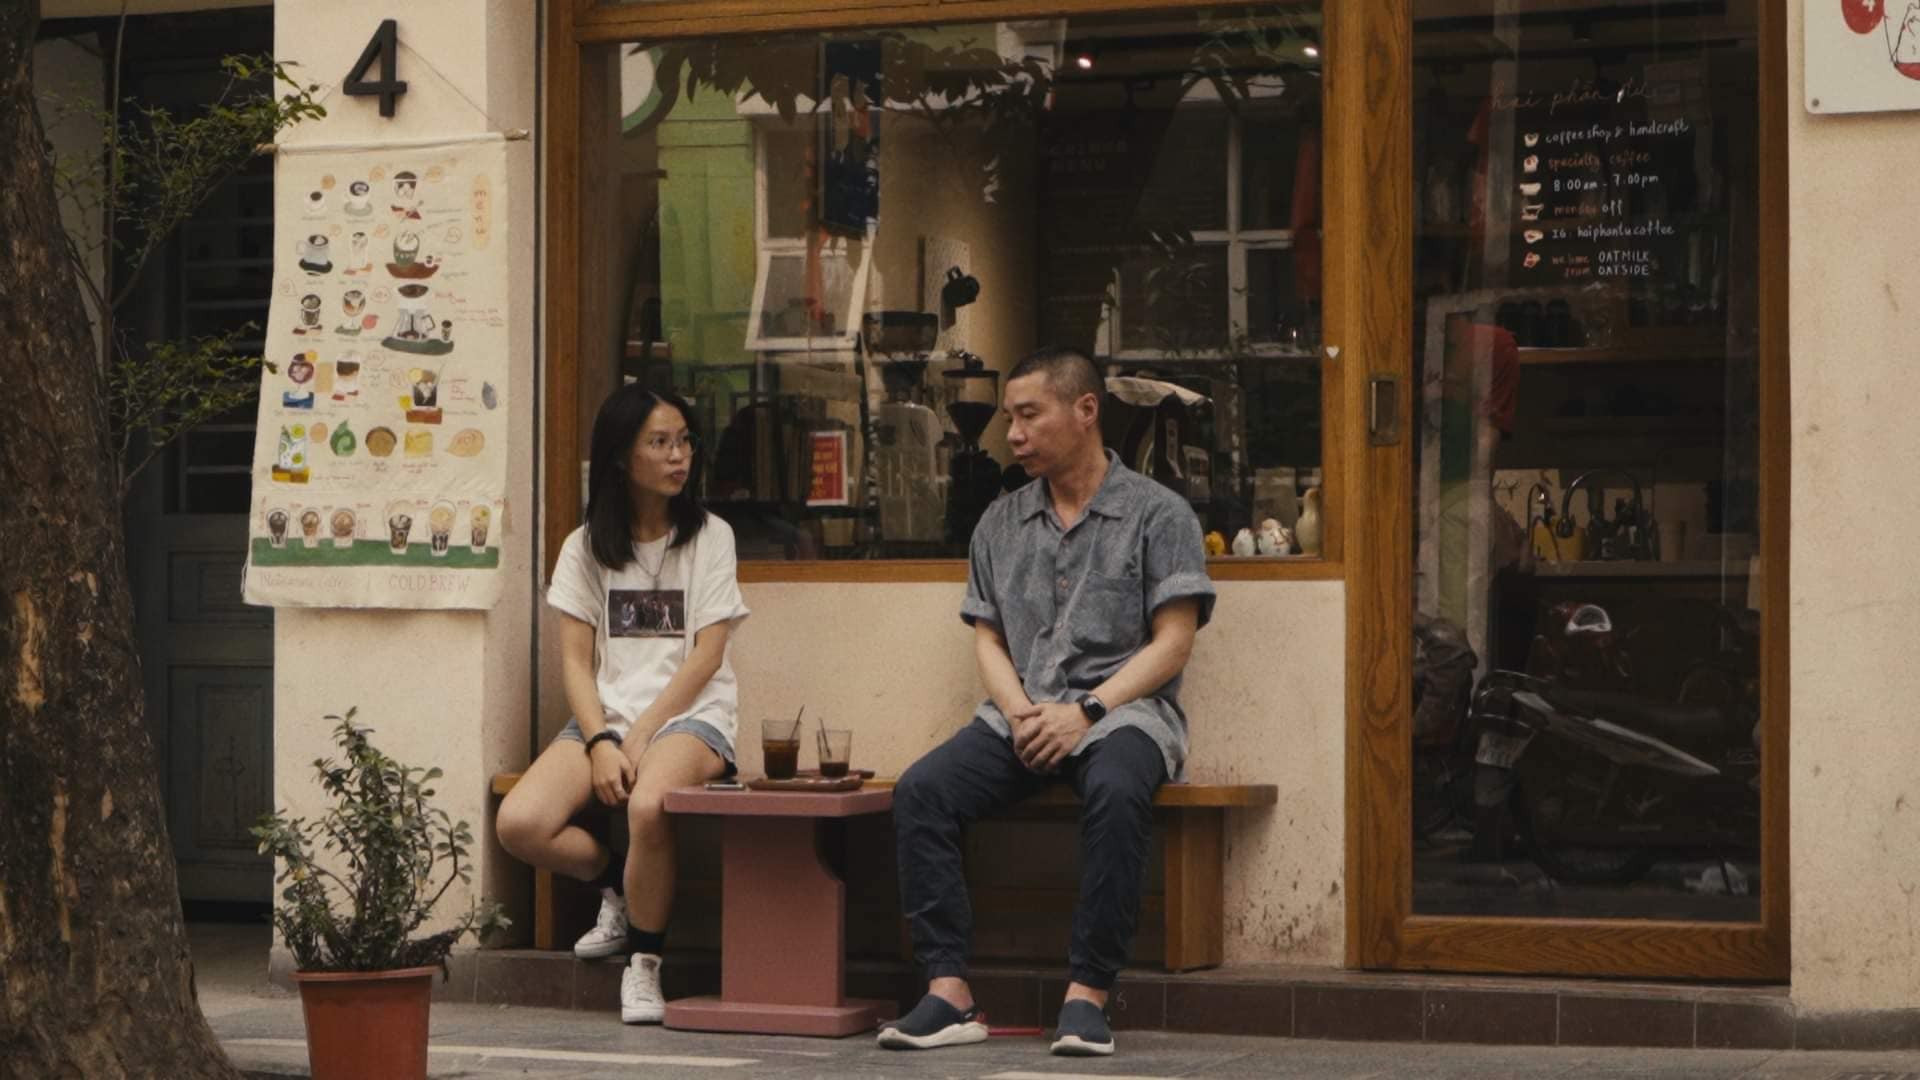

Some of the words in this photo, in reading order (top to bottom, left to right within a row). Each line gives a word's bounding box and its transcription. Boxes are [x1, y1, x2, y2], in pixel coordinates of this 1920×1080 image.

[342, 18, 408, 118] 4
[1545, 130, 1584, 145] coffee
[1586, 123, 1612, 144] shop
[1629, 117, 1689, 136] handcraft
[1602, 199, 1623, 216] off
[1597, 264, 1650, 277] OATSIDE
[388, 573, 426, 592] COLD
[429, 573, 472, 593] BREW
